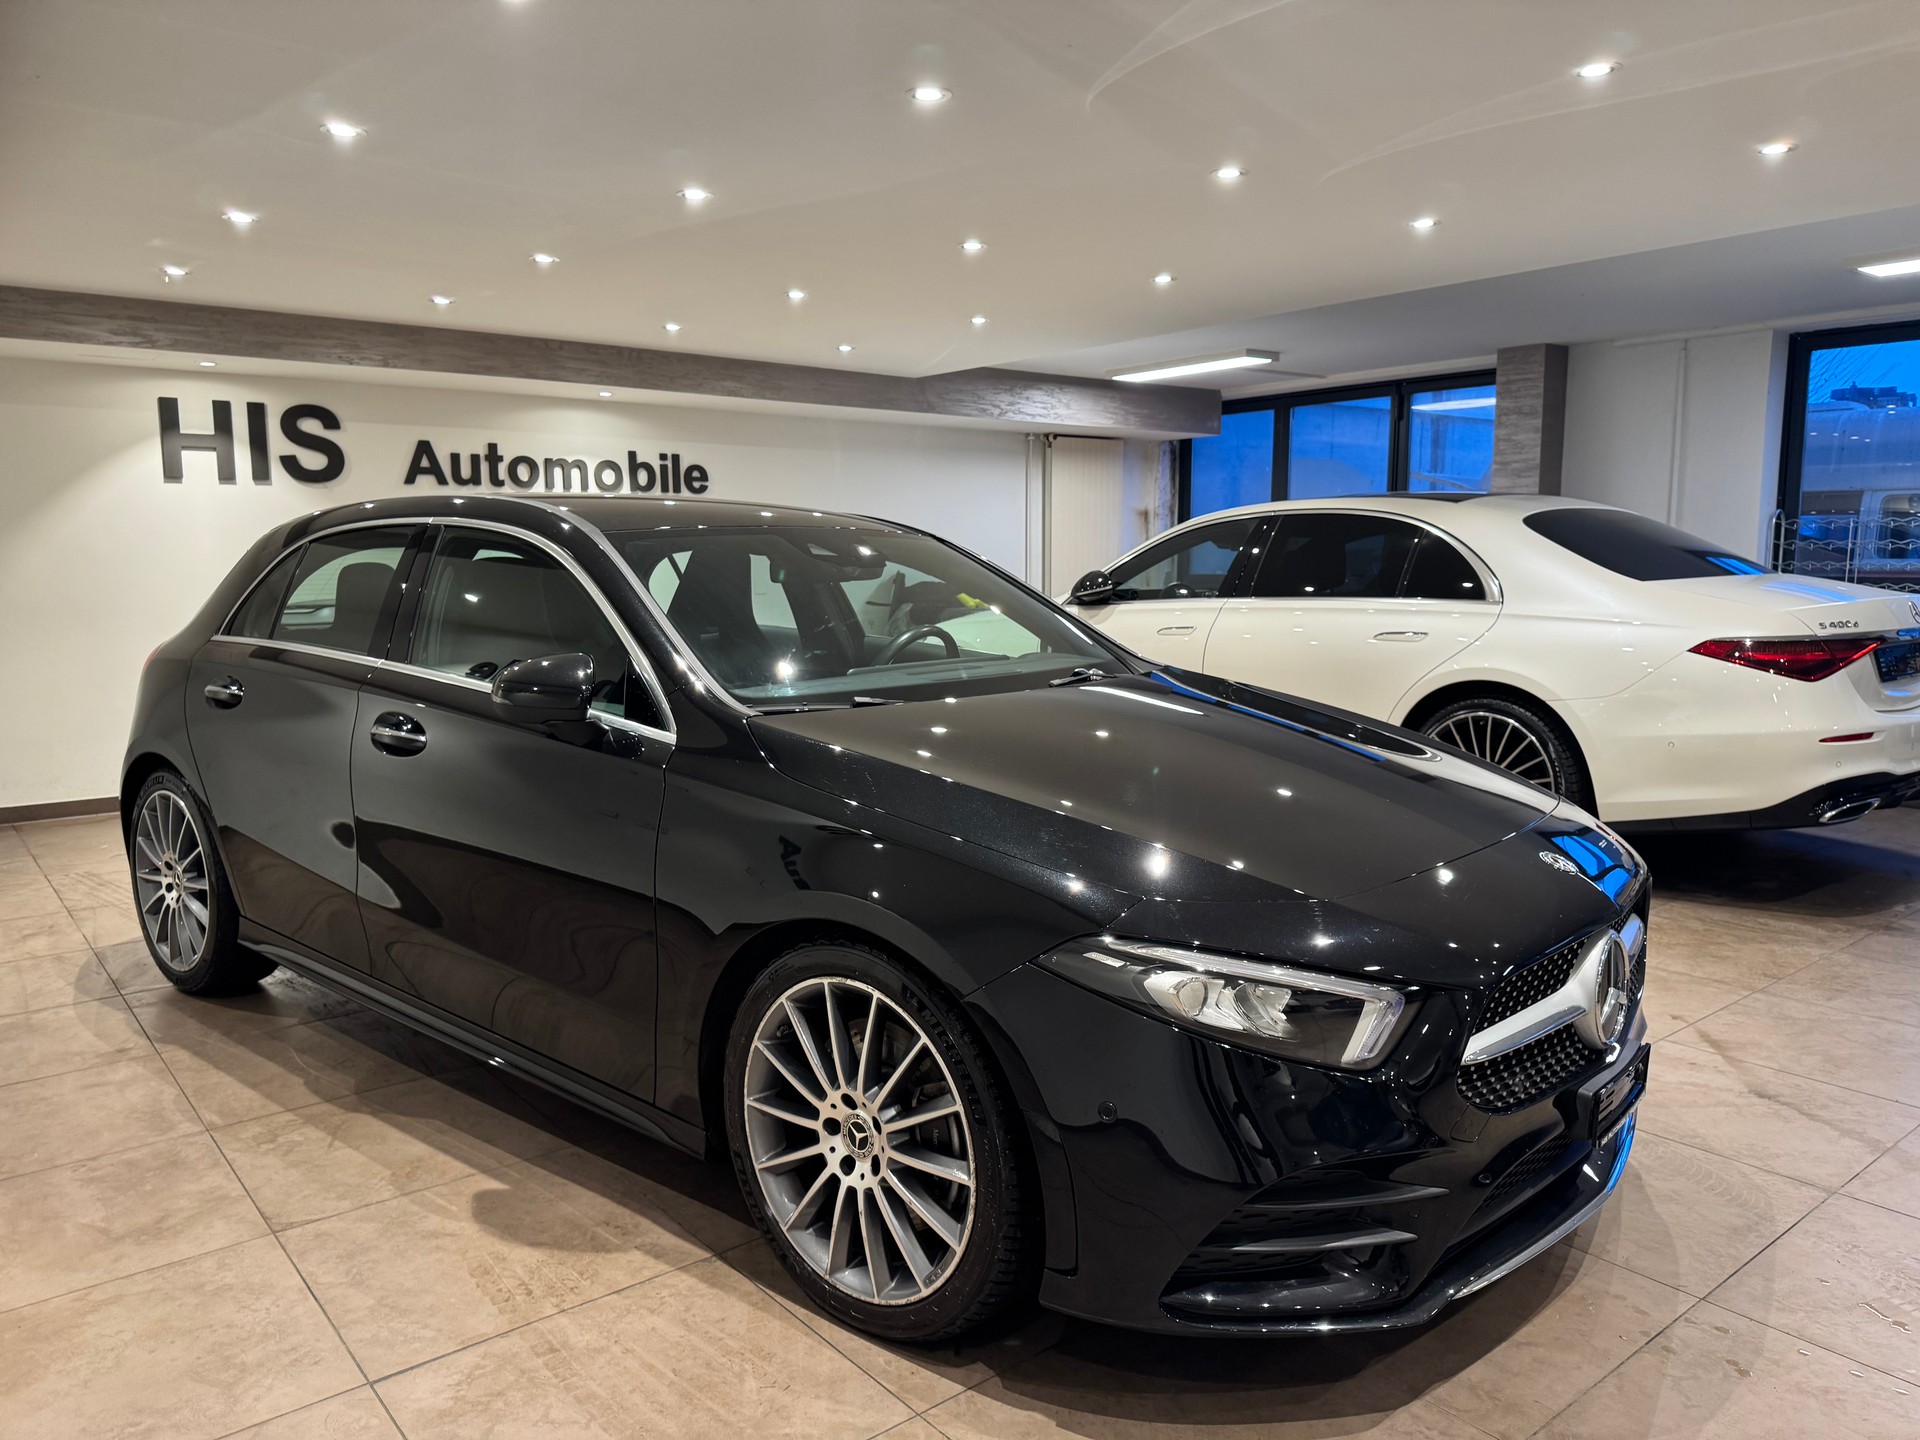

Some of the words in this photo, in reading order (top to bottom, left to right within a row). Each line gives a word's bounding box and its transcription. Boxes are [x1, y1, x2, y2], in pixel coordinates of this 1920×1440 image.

[158, 396, 346, 485] HIS
[404, 439, 710, 494] Automobile
[1818, 621, 1828, 630] S
[922, 1007, 984, 1121] MICHELIN
